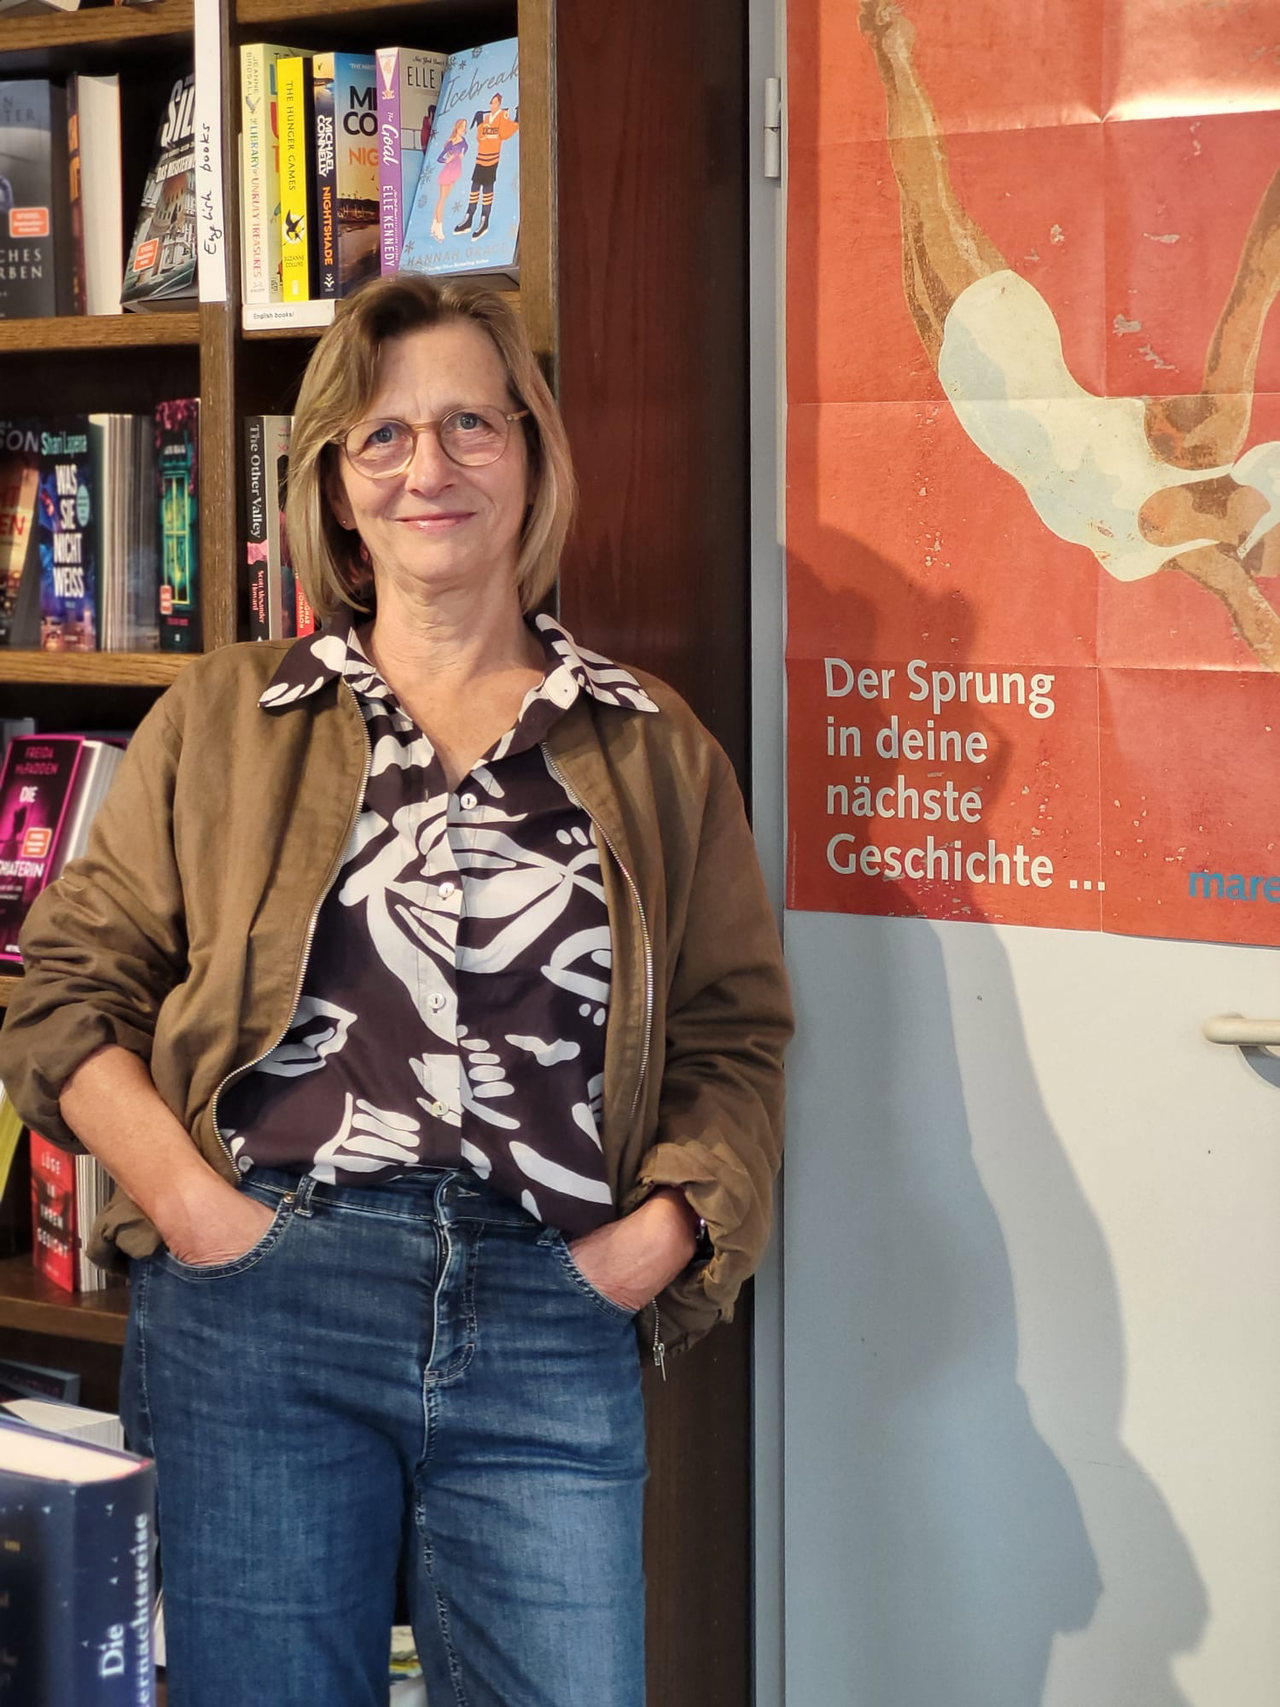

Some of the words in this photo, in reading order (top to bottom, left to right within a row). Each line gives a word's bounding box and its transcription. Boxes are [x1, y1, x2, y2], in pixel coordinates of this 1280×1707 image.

[286, 80, 294, 102] THE
[407, 66, 436, 89] ELLE
[161, 79, 195, 147] SIL
[286, 106, 295, 151] HUNGER
[343, 111, 378, 136] CO
[200, 122, 213, 172] books
[250, 122, 259, 169] LIBRARY
[317, 114, 329, 178] CONNELLY
[325, 116, 334, 170] MICHAEL
[381, 123, 399, 166] Goal
[288, 154, 297, 191] GAMES
[251, 177, 260, 219] UNRULY
[382, 185, 394, 211] ELLE
[322, 186, 333, 266] NIGHTSHADE
[383, 215, 395, 266] KENNEDY
[252, 223, 262, 278] TREASURES
[408, 250, 460, 266] HANNAH
[253, 312, 273, 320] English
[250, 424, 260, 452] The
[55, 463, 78, 496] WAS
[251, 455, 261, 496] Other
[60, 498, 76, 530] SIE
[251, 497, 263, 538] Valley
[53, 532, 82, 563] NICHT
[53, 567, 85, 598] WEISS
[824, 657, 895, 700] Der
[907, 659, 1056, 719] Sprung
[827, 716, 861, 757] in
[875, 716, 988, 763] deine
[19, 786, 38, 803] DIE
[826, 774, 982, 823] nächste
[826, 833, 1054, 888] Geschichte
[1188, 871, 1280, 903] mare
[130, 1512, 149, 1707] ernachtsreise
[98, 1623, 125, 1679] Die
